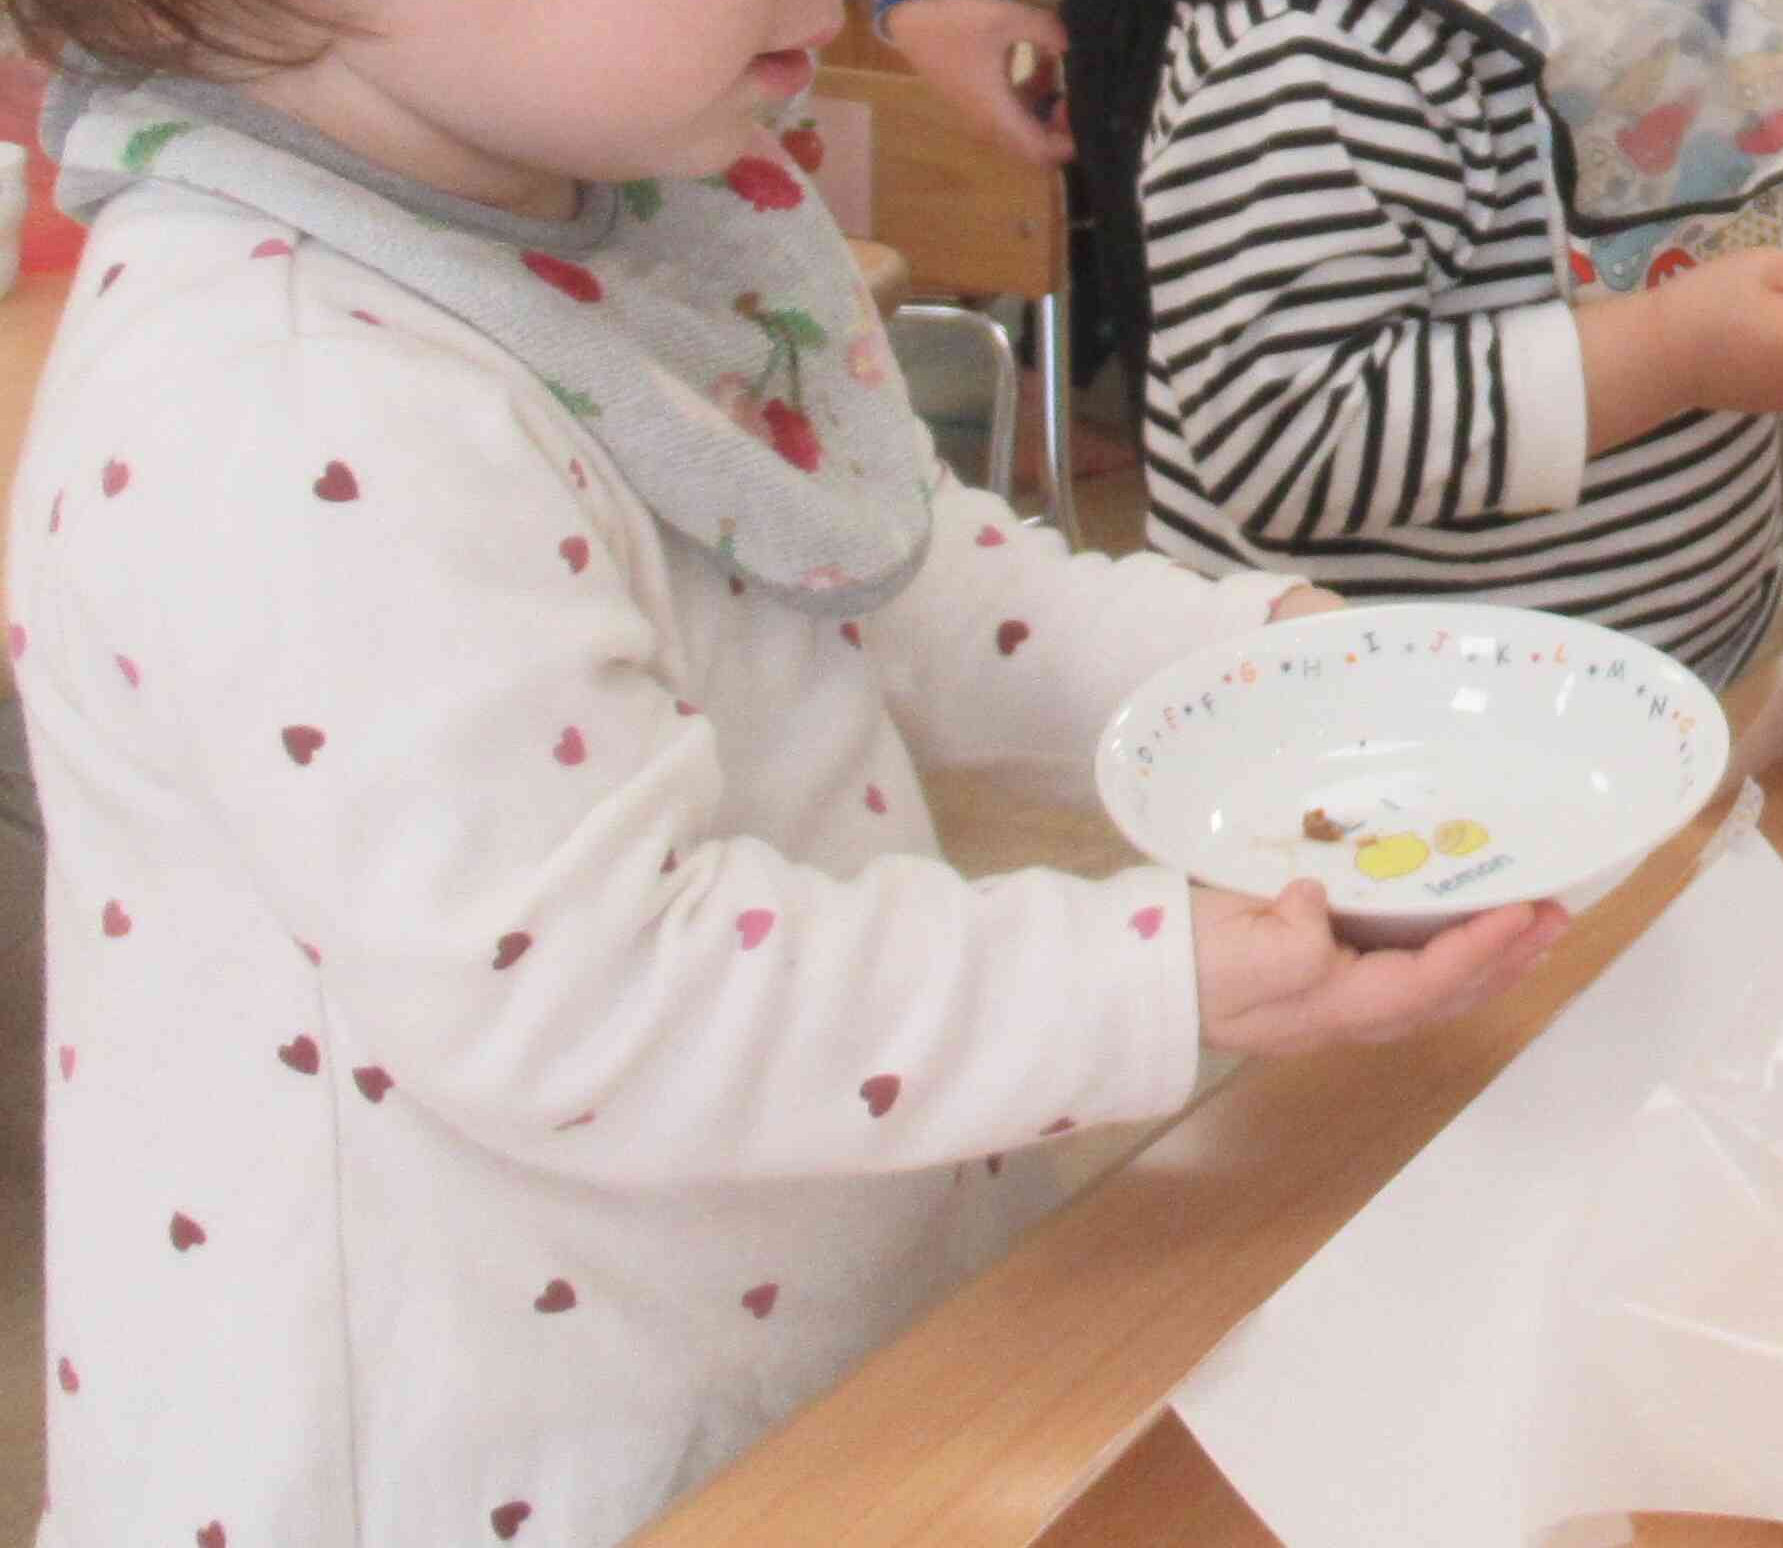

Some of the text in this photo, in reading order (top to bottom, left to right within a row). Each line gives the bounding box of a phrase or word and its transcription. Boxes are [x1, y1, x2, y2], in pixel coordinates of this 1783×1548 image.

[1303, 657, 1321, 680] H
[1363, 630, 1381, 653] I
[1429, 629, 1450, 653] J
[1497, 642, 1512, 666] K
[1606, 660, 1625, 678] M
[1648, 695, 1668, 718] N
[1424, 854, 1516, 897] lemon
